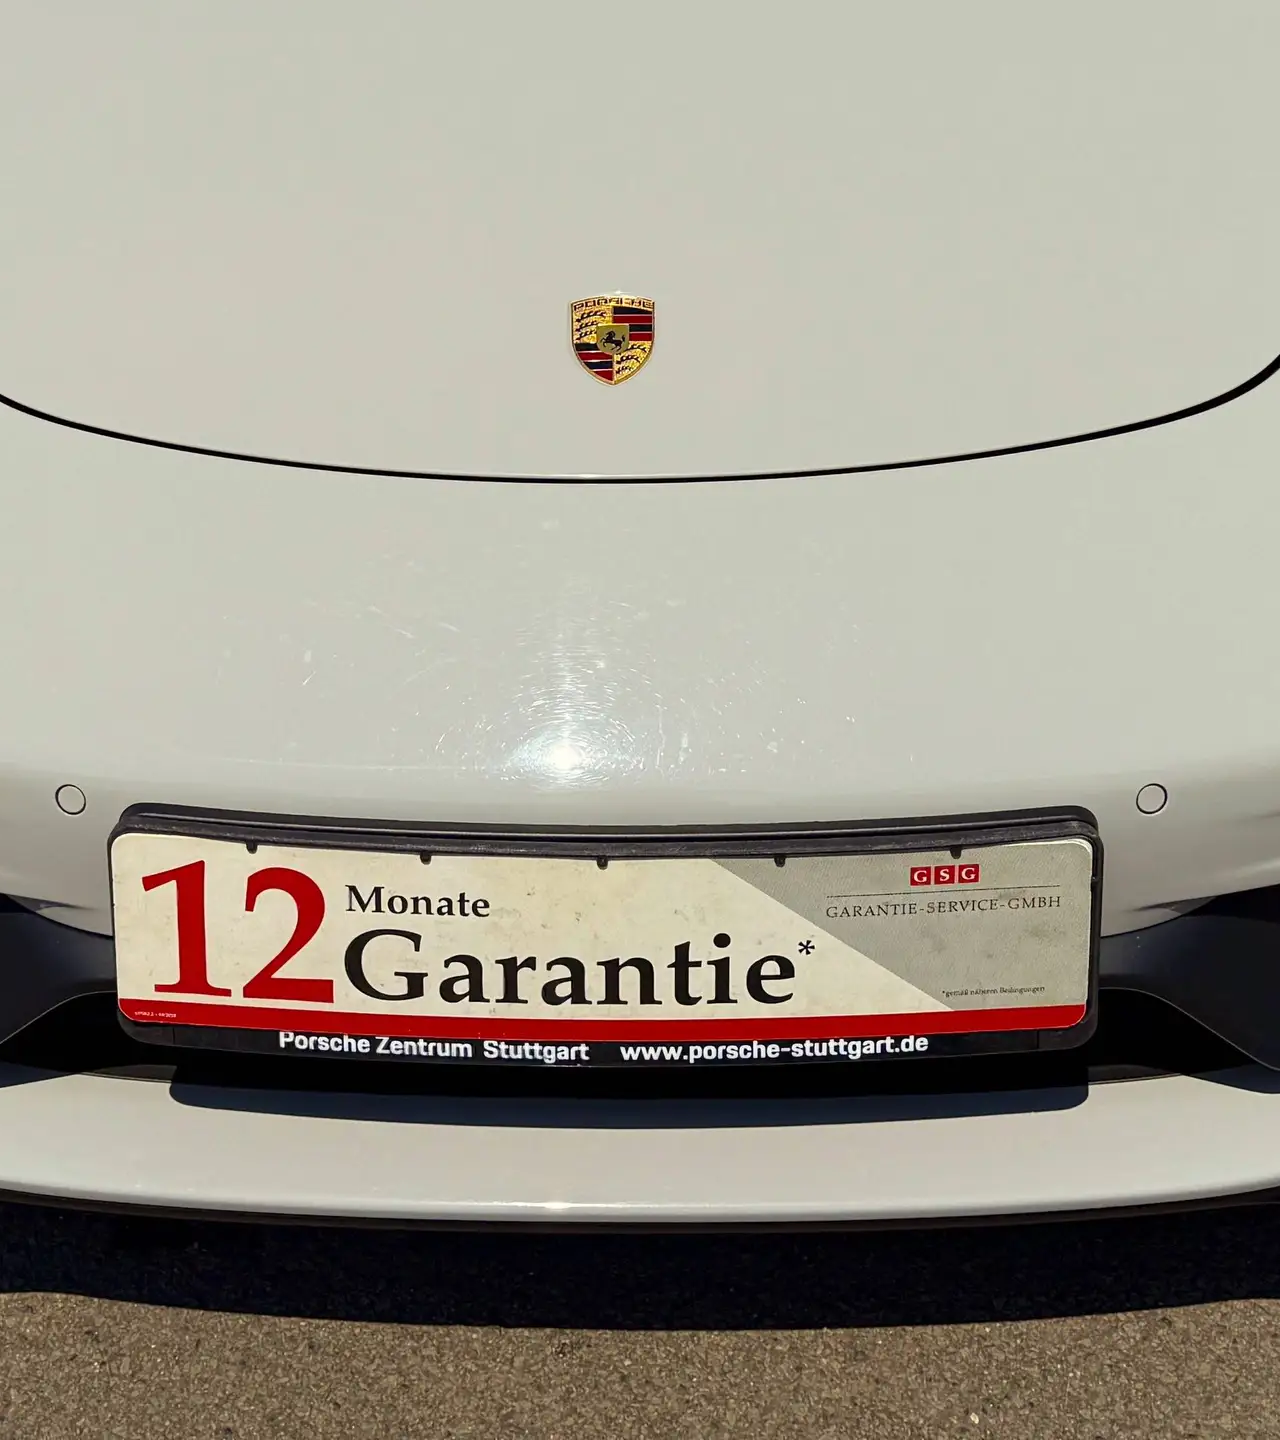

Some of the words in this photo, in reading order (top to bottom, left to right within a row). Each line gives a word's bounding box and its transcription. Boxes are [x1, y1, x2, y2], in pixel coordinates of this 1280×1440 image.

[911, 865, 978, 884] GSG
[344, 884, 491, 918] Monate
[825, 895, 1062, 919] GARANTIE-SERVICE-GMBH
[141, 859, 334, 1004] 12
[279, 1031, 370, 1054] Porsche
[376, 1035, 472, 1057] Zentrum
[483, 1040, 590, 1062] Stuttgart
[620, 1035, 929, 1064] www.porsche-stuttgart.de
